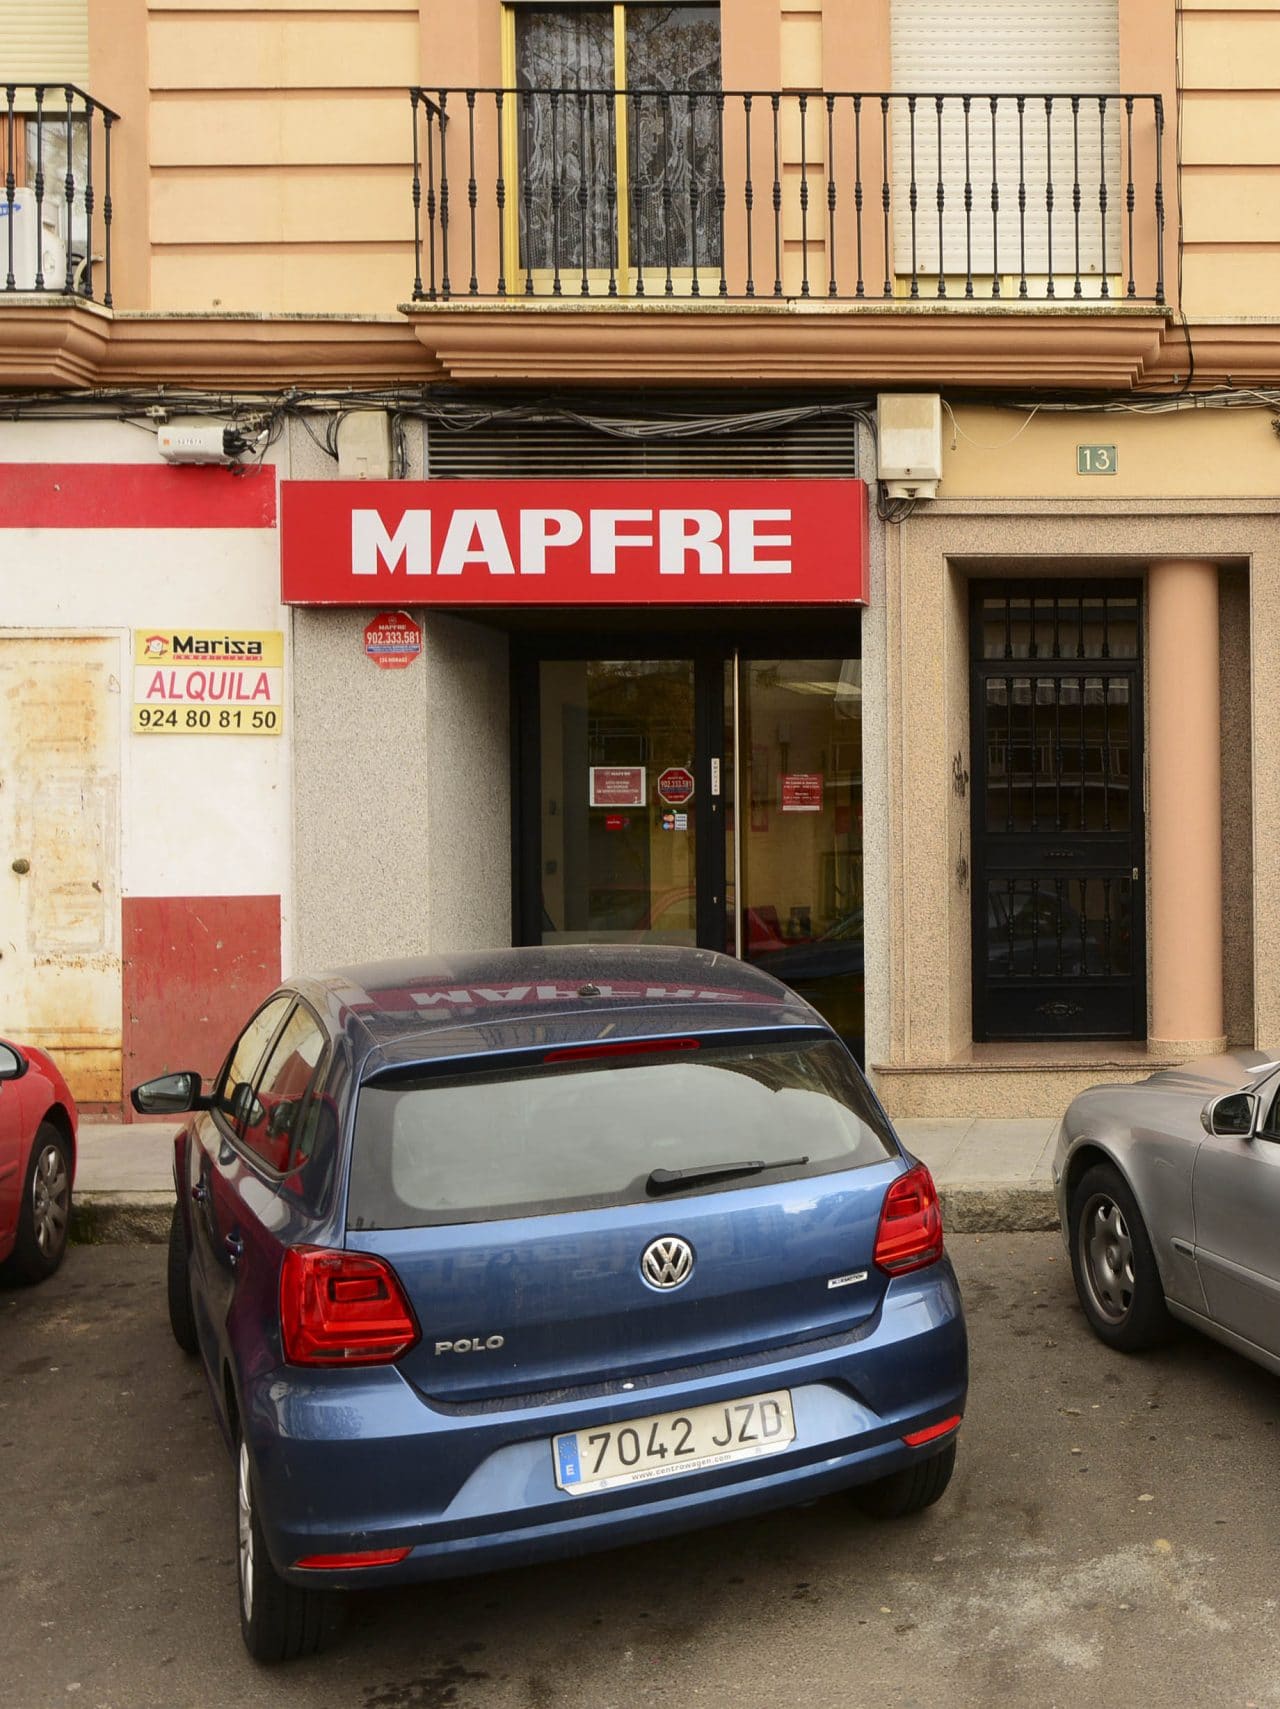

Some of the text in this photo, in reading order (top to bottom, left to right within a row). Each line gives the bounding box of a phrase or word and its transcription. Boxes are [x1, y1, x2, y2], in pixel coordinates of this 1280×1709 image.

[1083, 449, 1110, 470] 13
[352, 509, 791, 574] MAPFRE
[173, 635, 262, 654] Marisa
[367, 631, 419, 644] 902.333.581
[146, 670, 271, 701] ALQUILA
[139, 709, 276, 728] 924 80 81 50
[435, 1335, 504, 1355] POLO
[565, 1399, 783, 1476] E 7042 JZD
[632, 1454, 731, 1480] www.centrowagen.com
